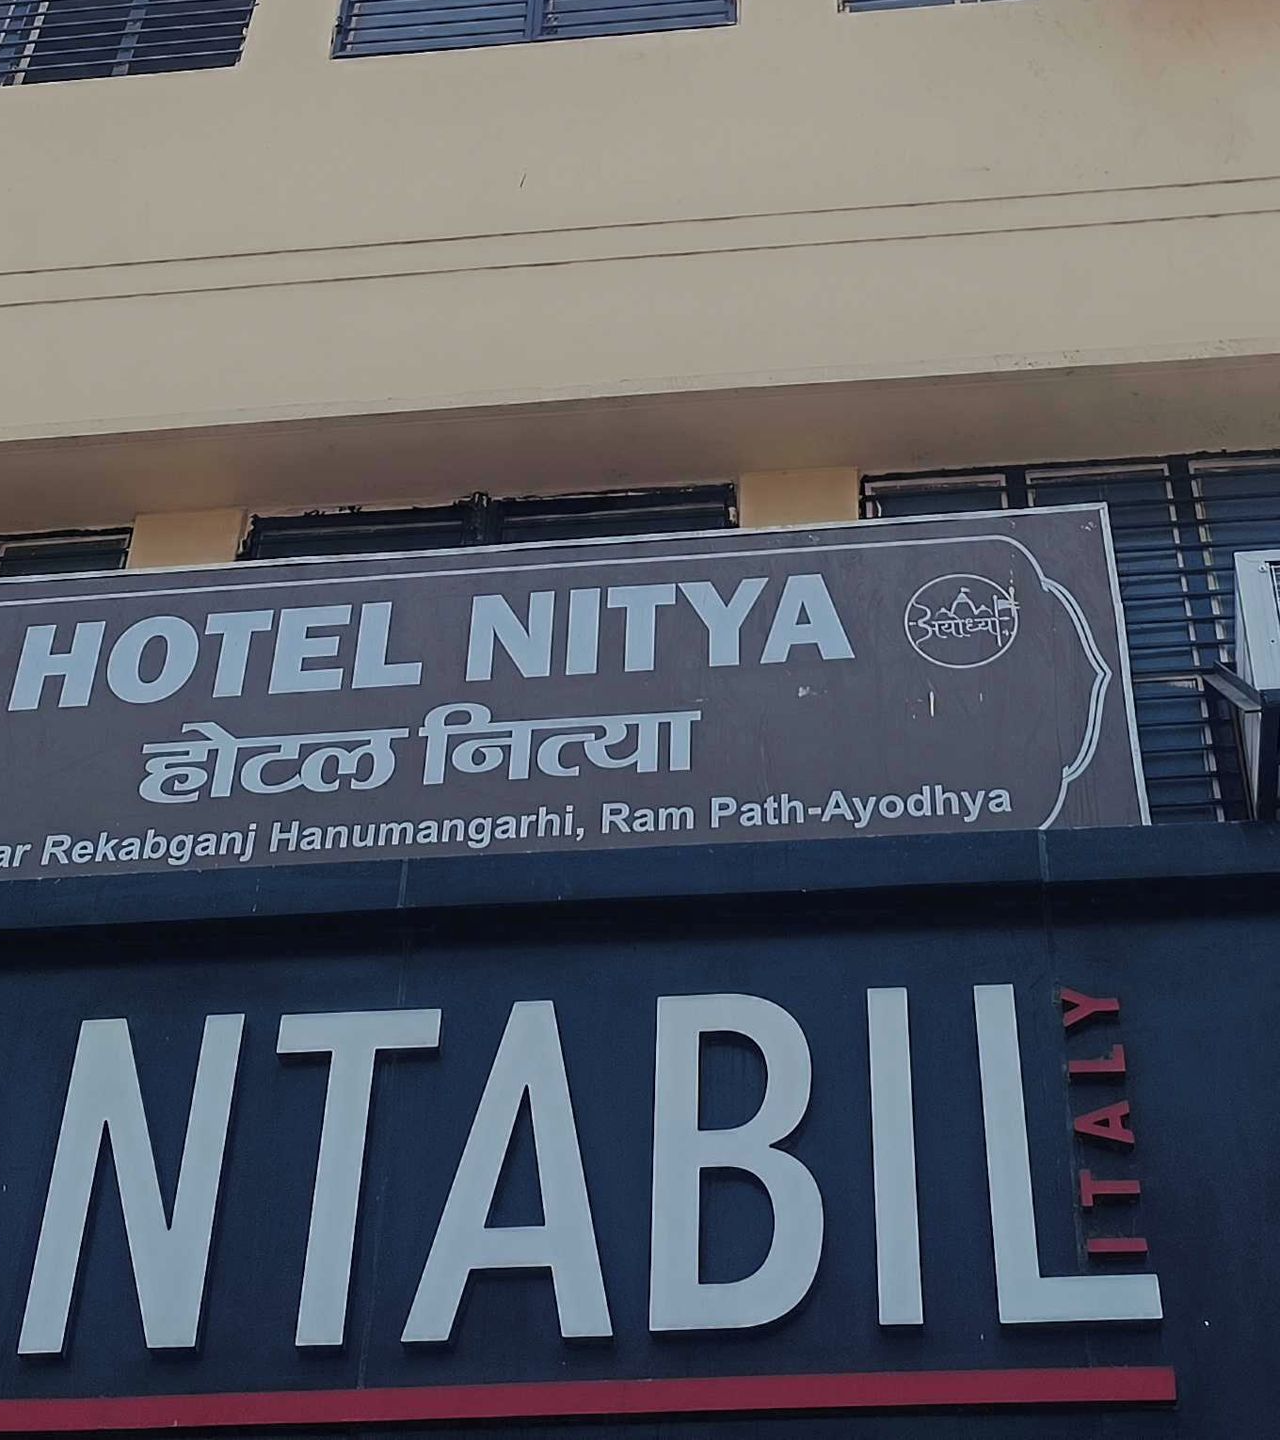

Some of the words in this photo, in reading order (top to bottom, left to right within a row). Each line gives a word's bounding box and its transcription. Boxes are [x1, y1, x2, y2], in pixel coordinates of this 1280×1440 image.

[7, 601, 422, 713] HOTEL
[464, 572, 856, 683] NITYA
[138, 721, 410, 804] होटल
[419, 702, 702, 786] नित्या
[40, 823, 258, 867] Rekabganj
[268, 804, 586, 853] Hanumangarhi,
[601, 802, 695, 834] Ram
[710, 784, 1012, 829] Path-Ayodhya
[1059, 986, 1149, 1253] ITALY
